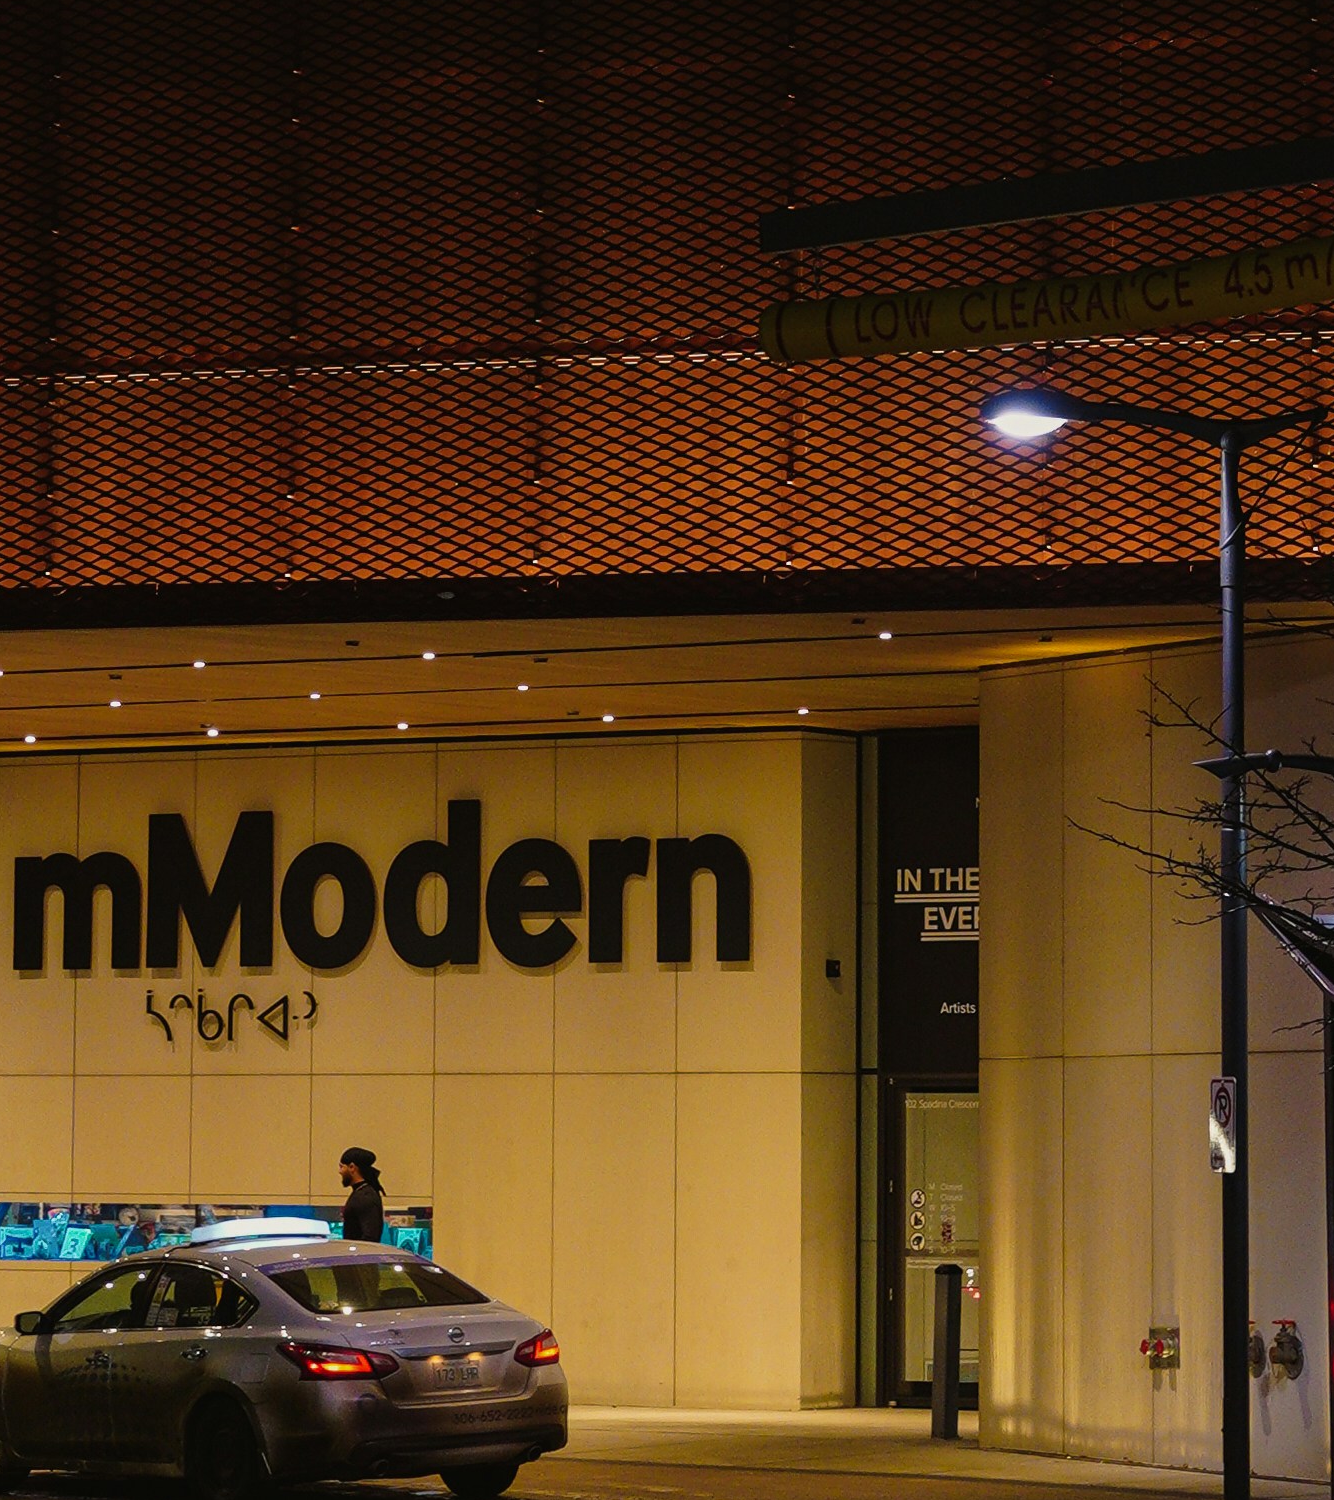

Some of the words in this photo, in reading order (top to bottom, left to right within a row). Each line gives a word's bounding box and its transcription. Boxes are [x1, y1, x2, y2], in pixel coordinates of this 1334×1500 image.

[855, 297, 932, 343] LOW
[1224, 252, 1273, 298] 4.5
[12, 799, 753, 973] mModern
[896, 868, 922, 892] IN
[929, 867, 979, 891] THE
[940, 1001, 976, 1015] Artists
